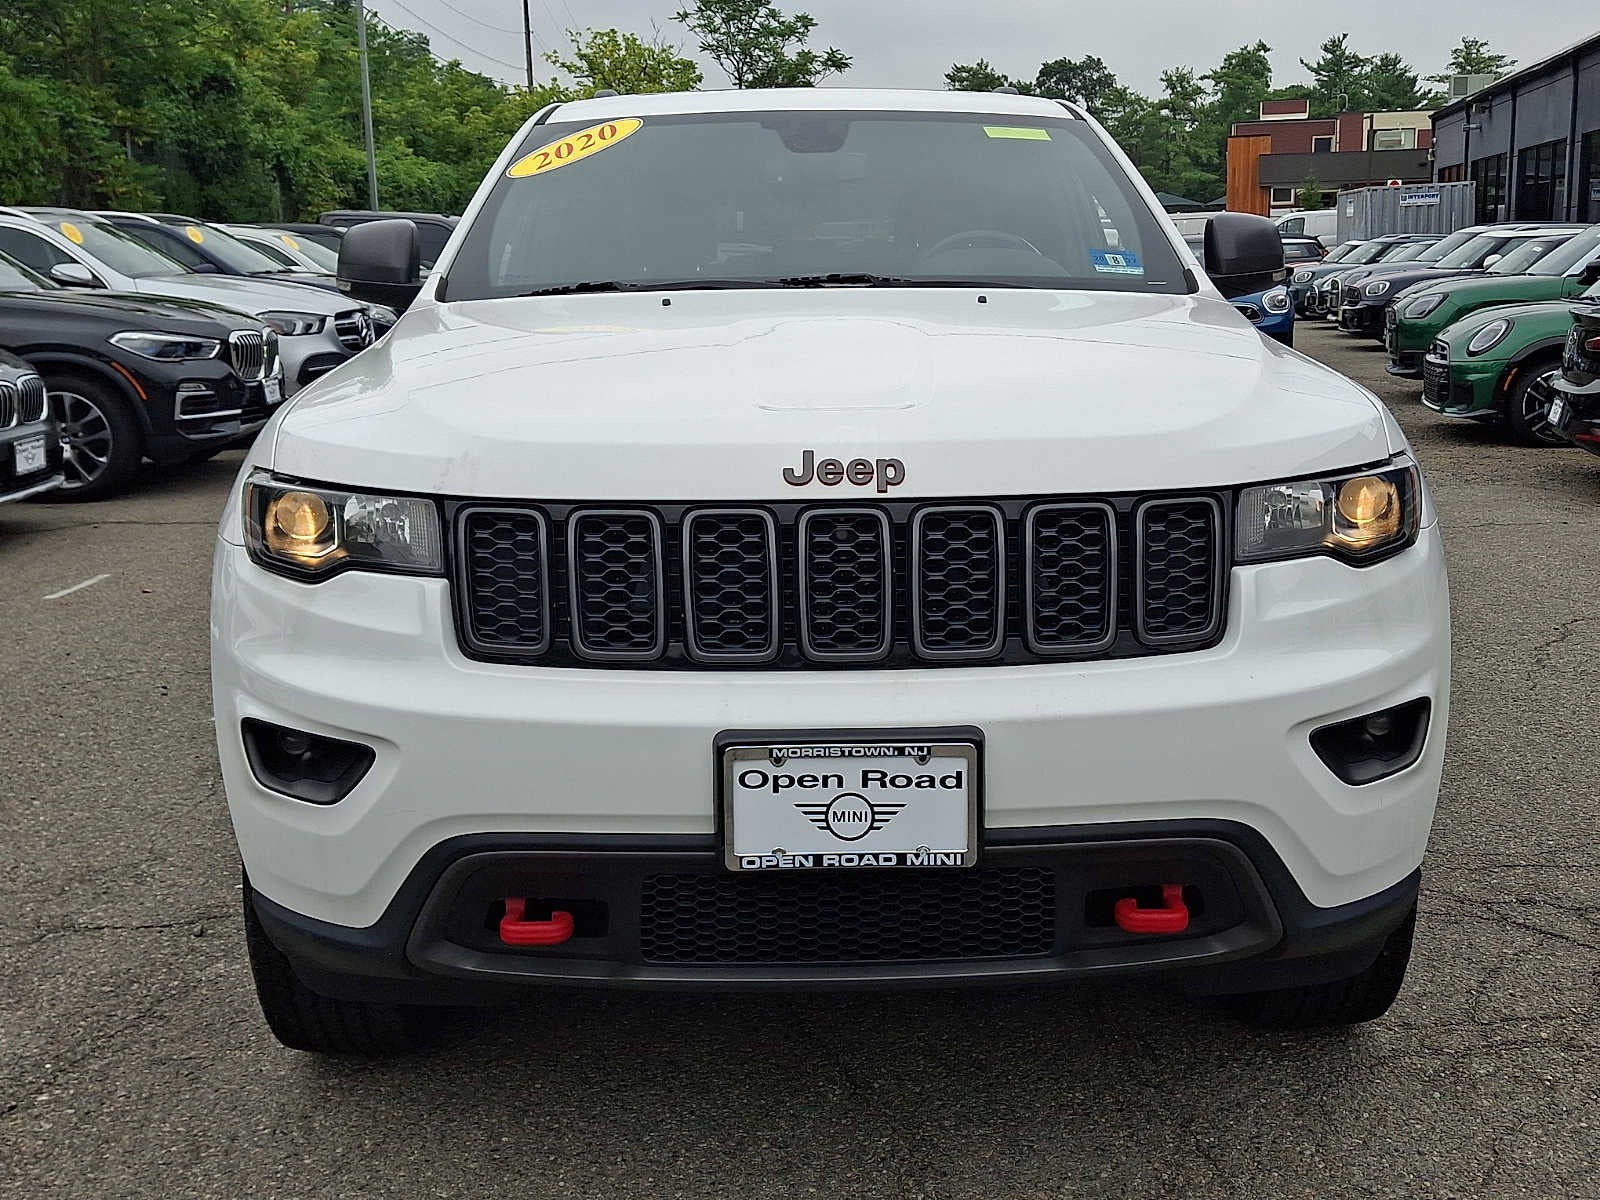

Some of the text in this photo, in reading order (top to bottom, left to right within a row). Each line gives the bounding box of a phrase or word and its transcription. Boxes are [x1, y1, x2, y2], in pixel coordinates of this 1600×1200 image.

[533, 124, 617, 170] 2020
[1111, 255, 1120, 265] 8
[782, 449, 906, 494] Jeep
[772, 746, 928, 759] MORRISTOWN, NJ
[737, 769, 963, 794] Open Road
[832, 810, 868, 823] MINI
[741, 852, 962, 869] OPEN ROAD MINI
